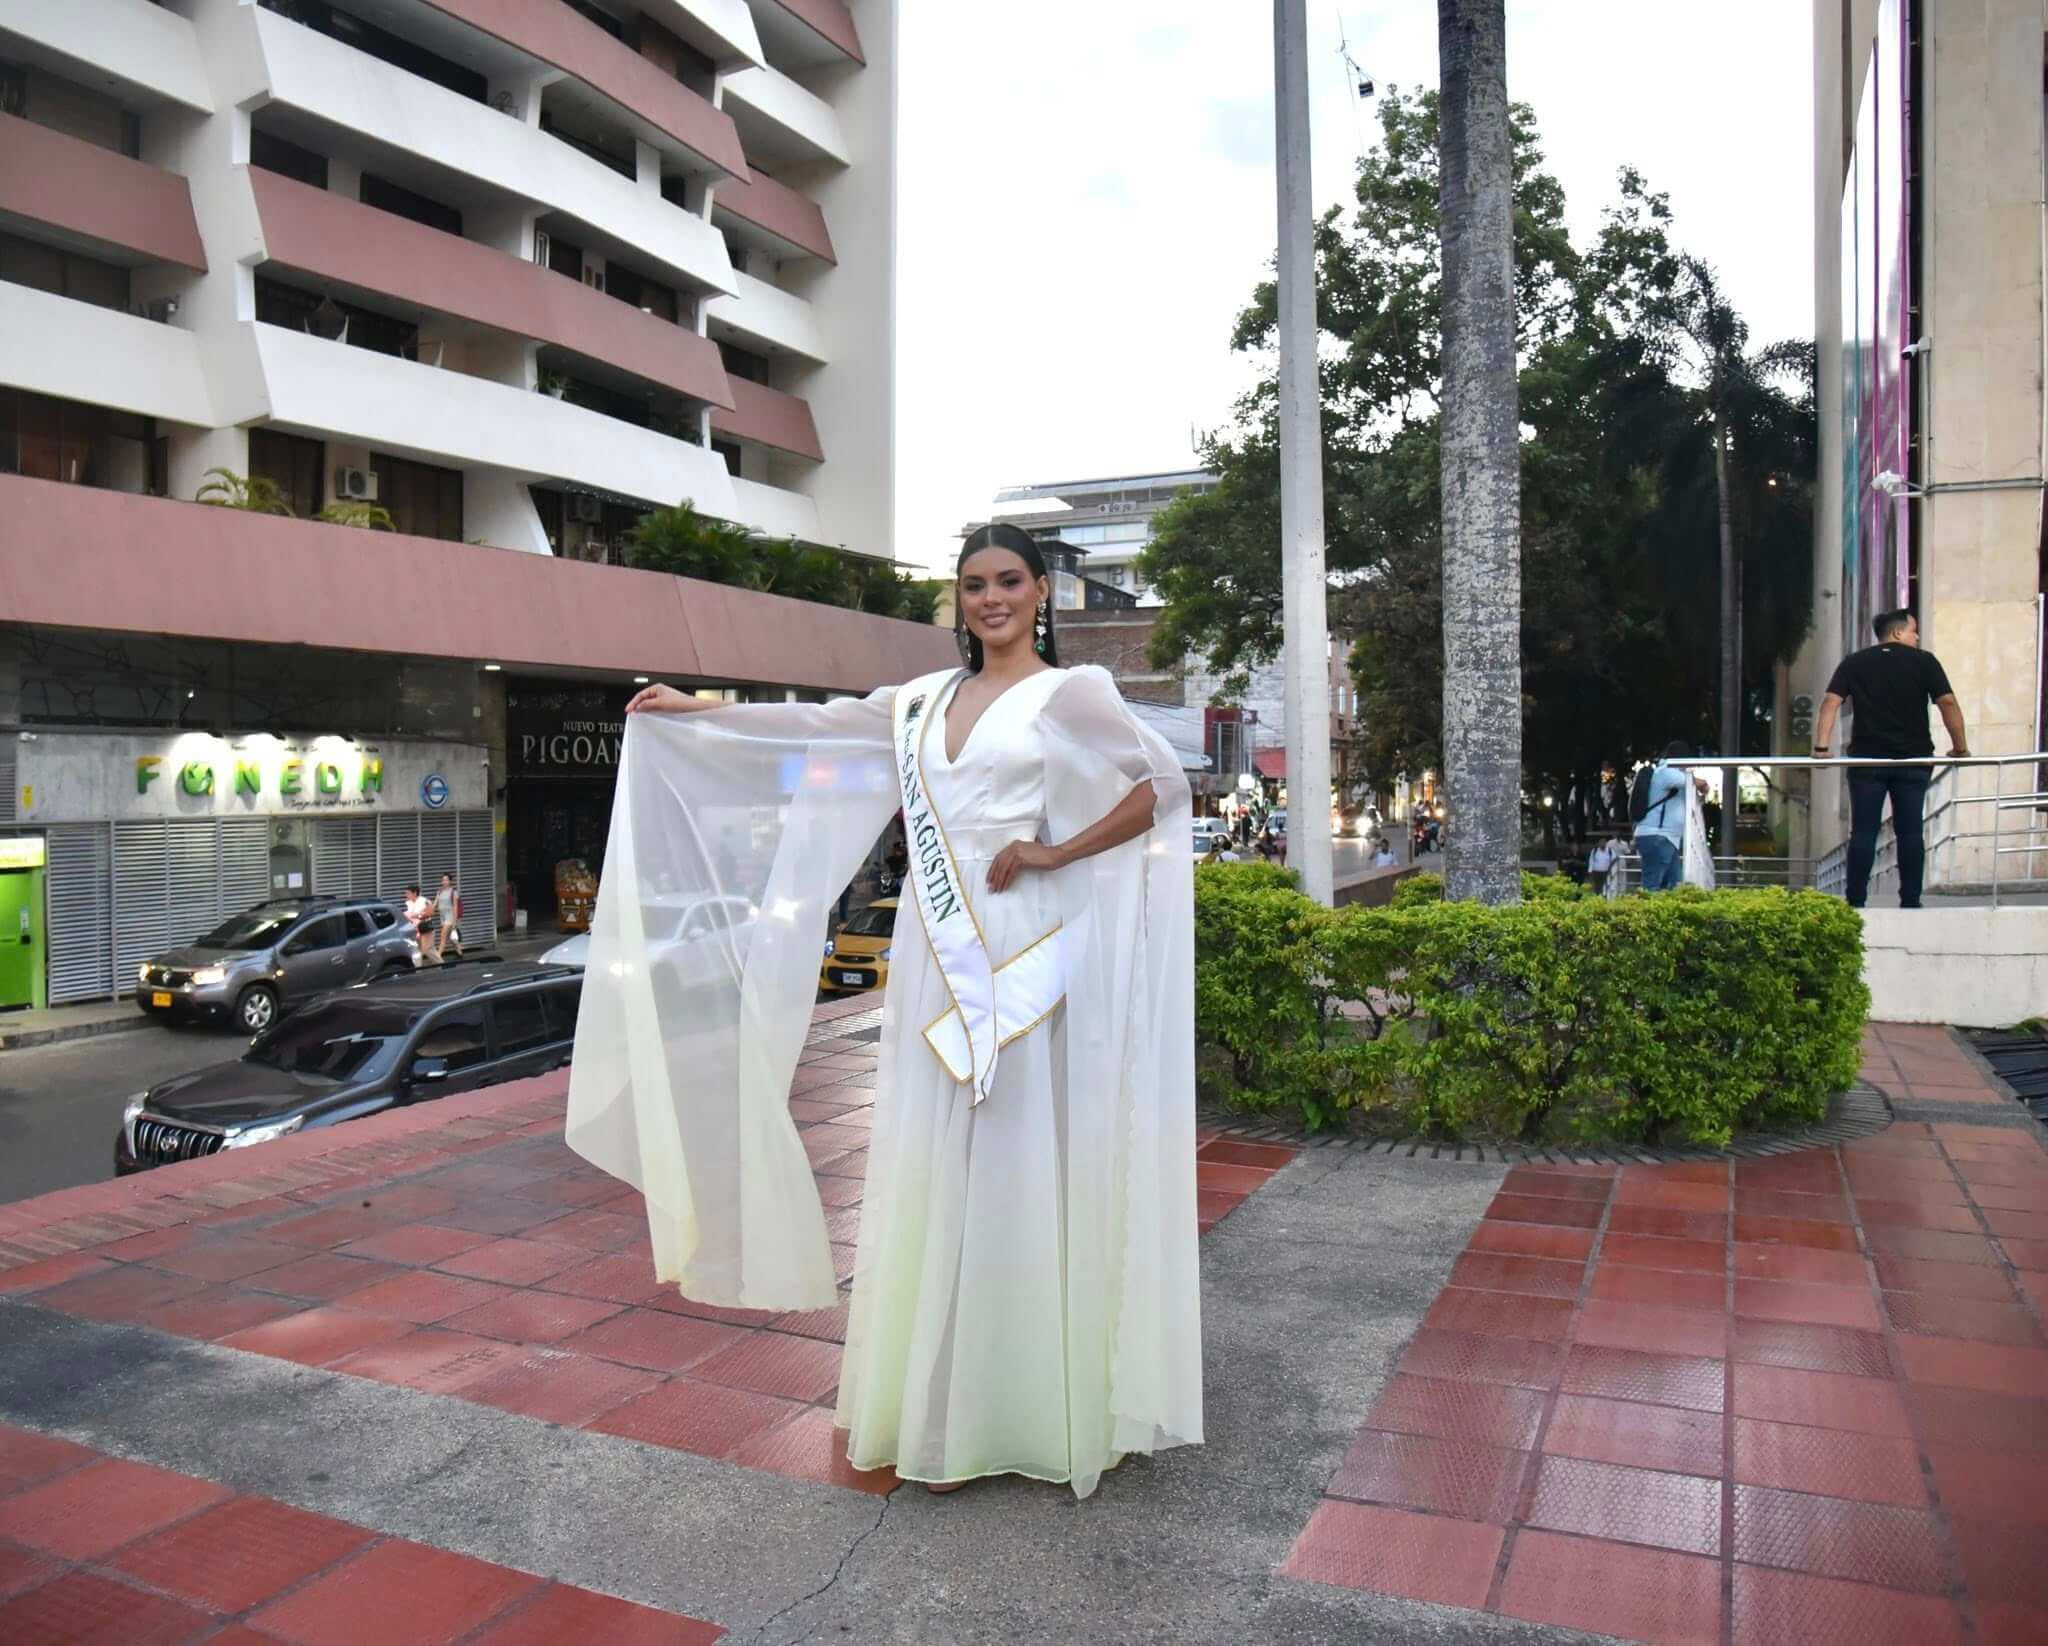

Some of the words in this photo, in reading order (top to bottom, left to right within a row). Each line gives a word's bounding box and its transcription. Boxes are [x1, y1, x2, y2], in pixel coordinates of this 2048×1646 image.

[563, 721, 595, 733] NUEVO
[136, 756, 384, 796] FONEDH
[902, 753, 921, 810] SAN
[912, 810, 961, 923] AGUSTIN
